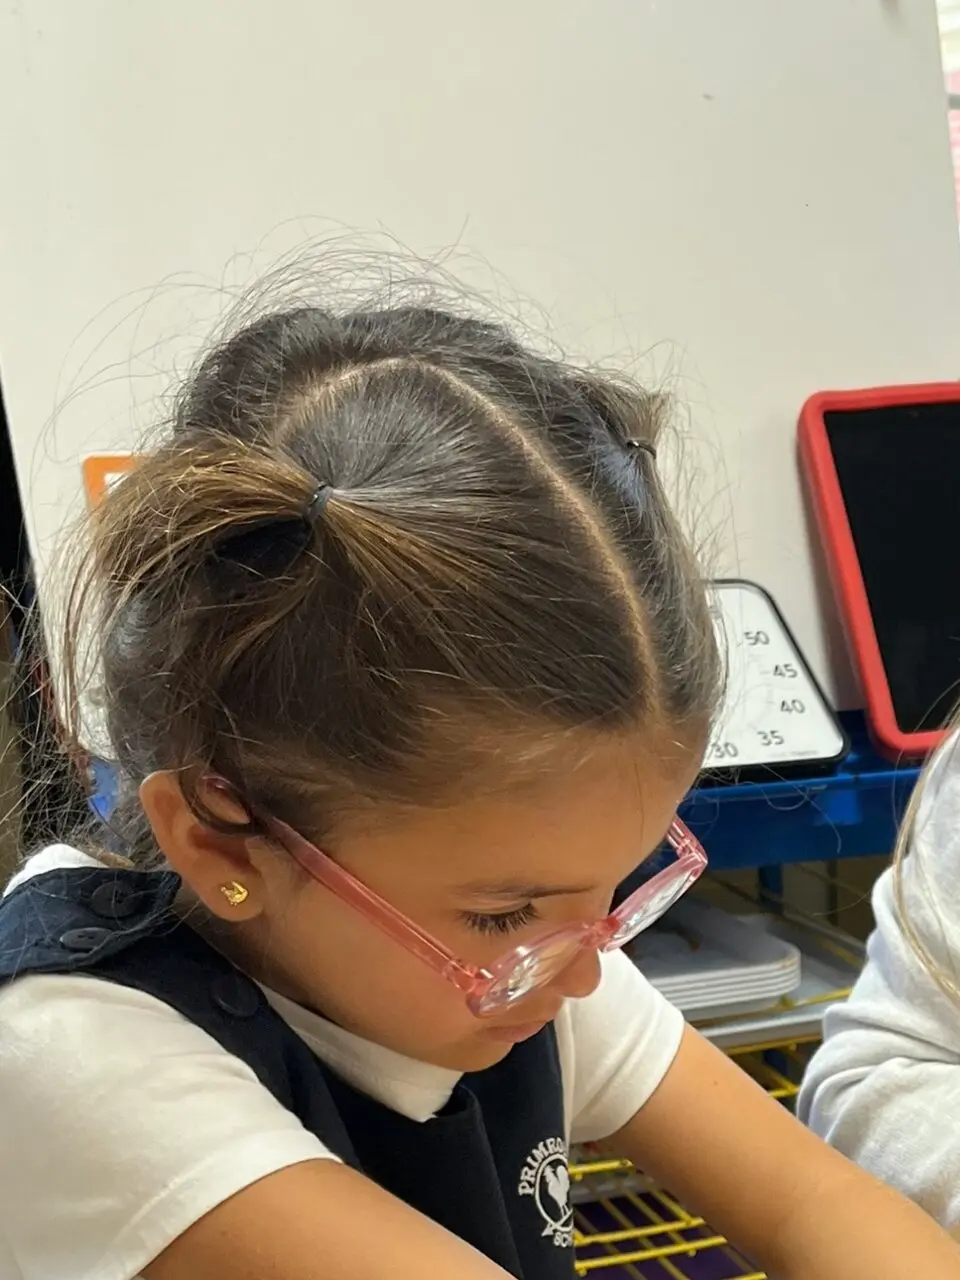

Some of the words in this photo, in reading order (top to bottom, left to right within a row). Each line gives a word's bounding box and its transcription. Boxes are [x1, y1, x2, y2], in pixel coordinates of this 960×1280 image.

[744, 630, 771, 647] 50
[772, 663, 799, 679] 45
[779, 699, 806, 715] 40
[757, 729, 785, 747] 35
[713, 742, 739, 759] 30
